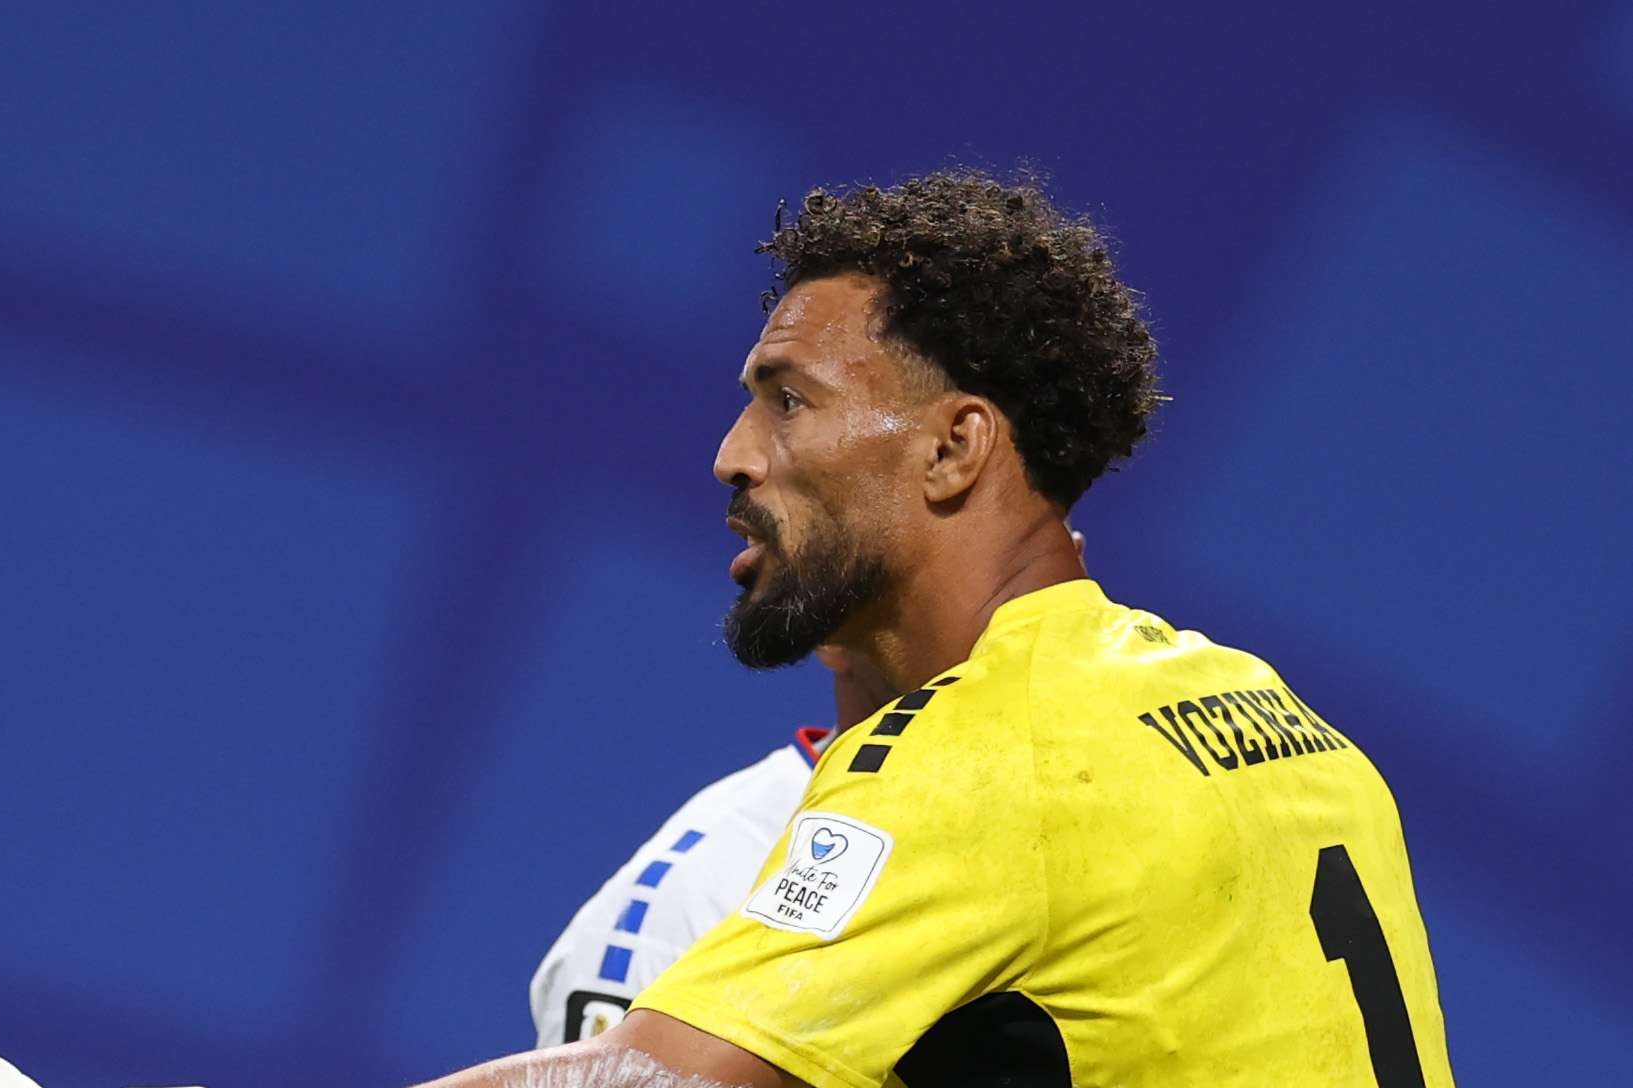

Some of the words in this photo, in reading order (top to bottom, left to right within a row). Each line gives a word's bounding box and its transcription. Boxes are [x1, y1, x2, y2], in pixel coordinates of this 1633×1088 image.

[1137, 687, 1348, 777] VOZINHA
[818, 871, 840, 891] For
[774, 878, 829, 914] PEACE
[777, 904, 804, 920] FIFA
